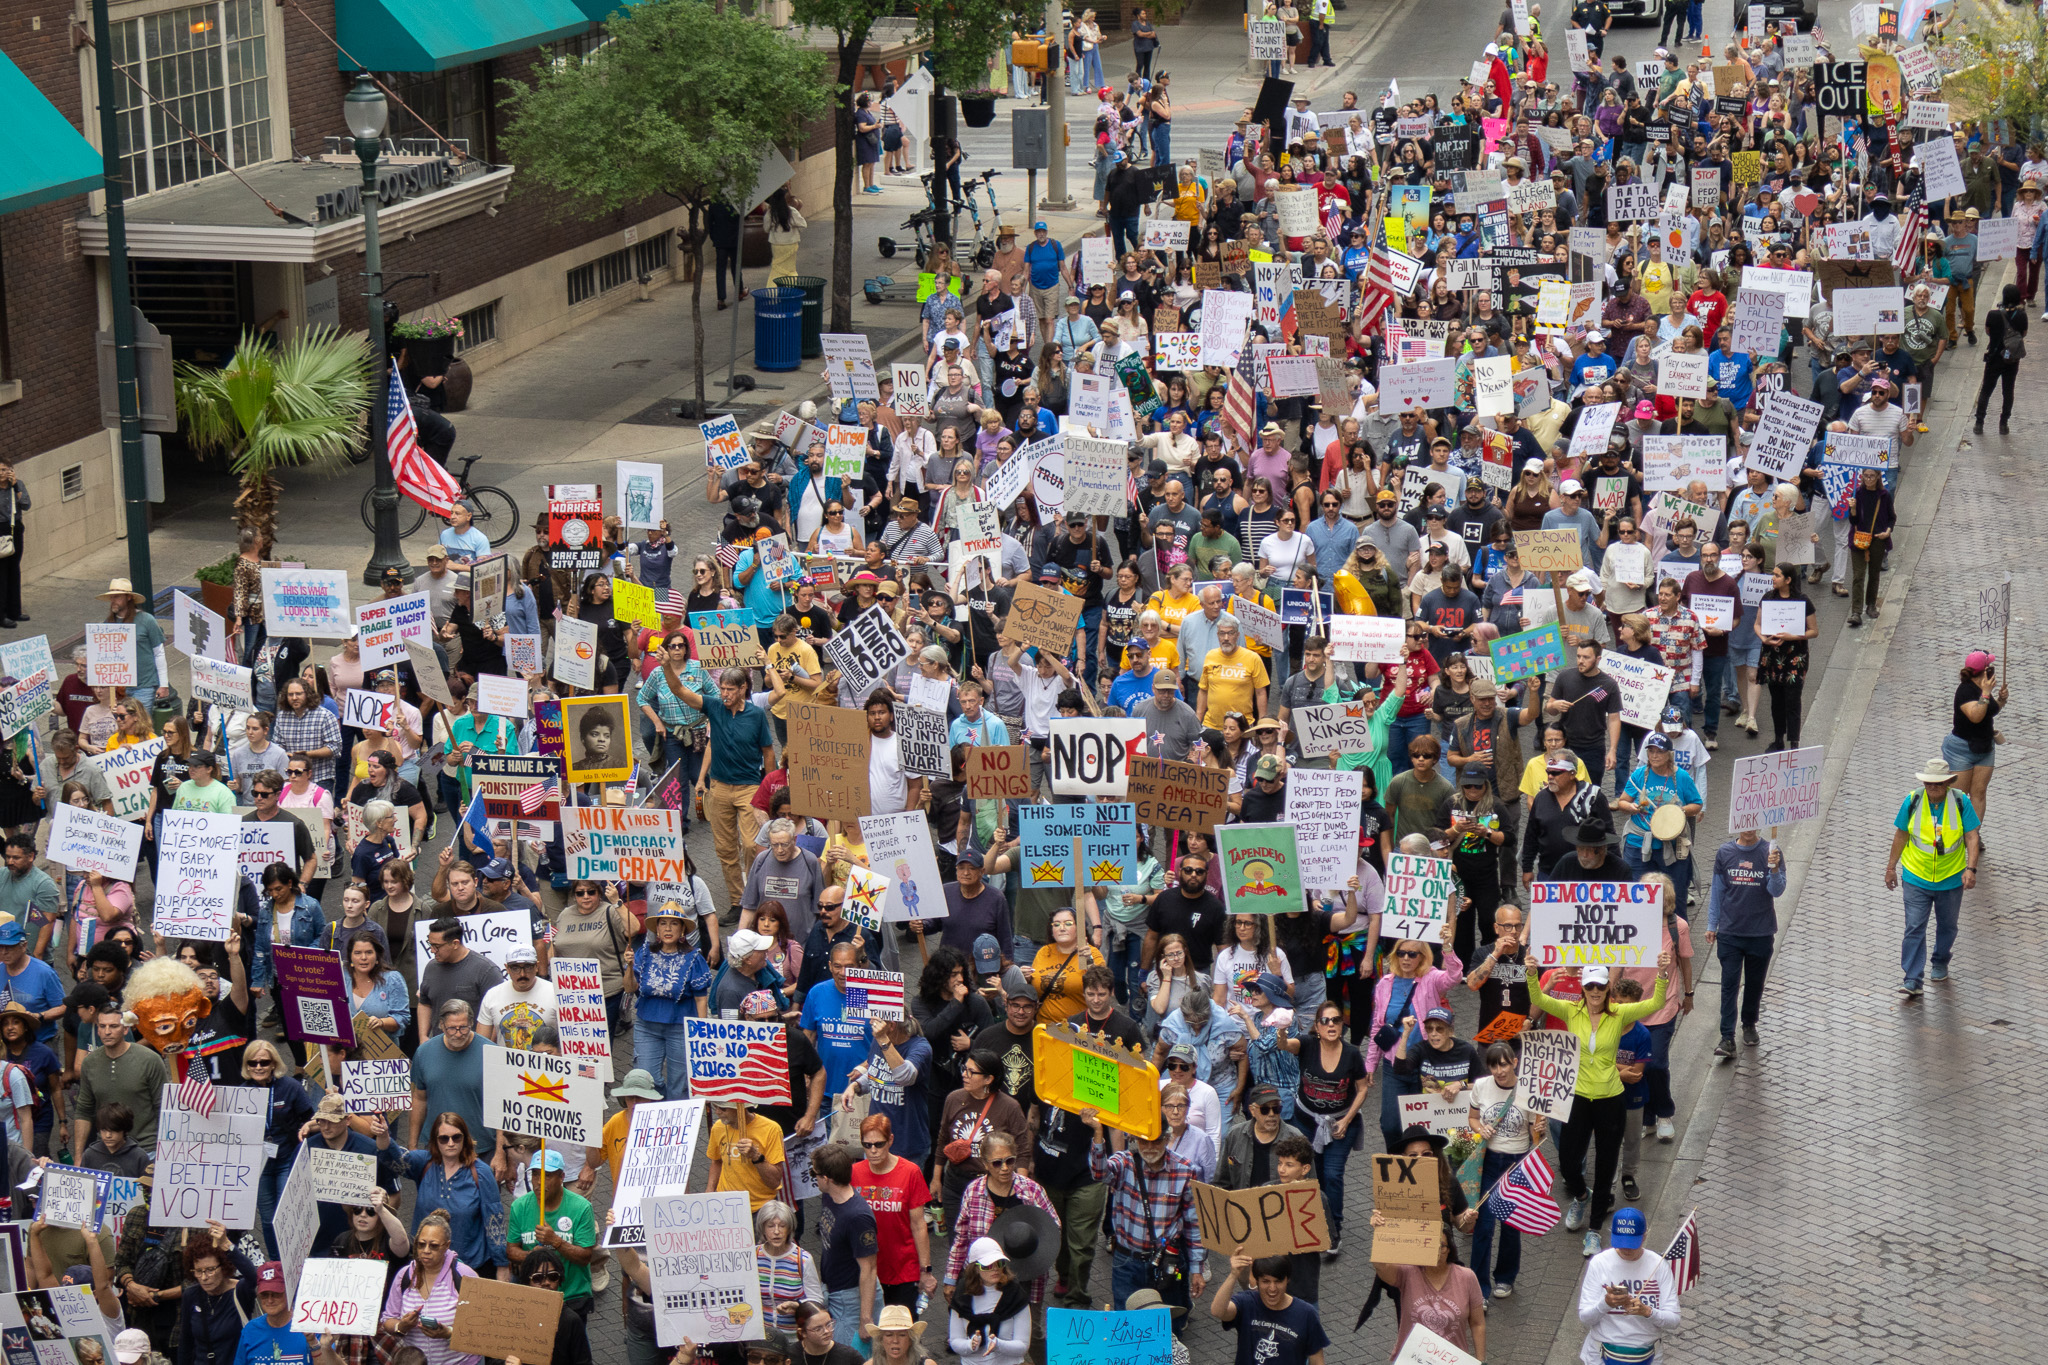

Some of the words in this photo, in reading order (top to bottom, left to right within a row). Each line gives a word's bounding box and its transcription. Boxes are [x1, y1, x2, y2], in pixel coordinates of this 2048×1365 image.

[1250, 22, 1285, 34] VETERAN
[1256, 37, 1281, 45] AGAINST
[1255, 48, 1282, 58] TRUMP
[1819, 86, 1865, 109] OUT
[1913, 105, 1945, 113] PATRIOTS
[1435, 140, 1470, 150] RAPIST
[1732, 152, 1751, 160] WHO
[1733, 160, 1758, 168] WOULD
[1696, 170, 1717, 180] STOP
[1733, 167, 1759, 175] JESUS
[1513, 186, 1554, 200] ILLEGAL
[1617, 186, 1649, 197] RATA
[1697, 187, 1717, 196] PEDO
[1520, 201, 1547, 213] LAND
[1616, 199, 1632, 208] DE
[1638, 198, 1658, 208] DOS
[1697, 196, 1718, 205] FILES
[1615, 209, 1658, 220] PATAS
[1740, 292, 1784, 307] KINGS
[1734, 320, 1779, 334] PEOPLE
[1738, 335, 1775, 352] RISE
[898, 371, 919, 387] NO
[1668, 372, 1694, 381] EXHAUST
[897, 392, 925, 403] KINGS
[828, 425, 864, 445] Chinga
[1066, 439, 1126, 455] DEMOCRACY
[1768, 436, 1778, 446] DO
[1780, 439, 1796, 451] NOT
[1756, 444, 1794, 461] MISTREAT
[825, 457, 862, 475] Migra
[1758, 454, 1784, 472] THEM
[1606, 479, 1622, 491] NO
[551, 503, 601, 512] WORKERS
[1598, 492, 1624, 507] WAR
[965, 537, 1001, 552] TYRANTS
[1514, 534, 1530, 543] NO
[1533, 532, 1576, 543] CROWN
[551, 551, 581, 560] MAKE
[583, 551, 600, 560] OUR
[1520, 554, 1579, 568] CLOWN
[552, 560, 570, 568] CITY
[572, 560, 599, 568] RUN!
[283, 597, 328, 606] DEMOCRACY
[284, 607, 309, 616] LOOKS
[312, 607, 330, 617] LIKE
[360, 608, 386, 621] SUPER
[389, 599, 425, 615] CALLOUS
[1436, 608, 1464, 628] 250
[361, 619, 392, 635] FRAGILE
[396, 611, 426, 626] RACIST
[94, 633, 127, 642] EPSTEIN
[366, 632, 393, 647] SEXIST
[700, 629, 751, 646] HANDS
[870, 607, 906, 656] NO
[99, 643, 123, 652] FILES
[711, 645, 739, 658] OFF
[854, 619, 897, 669] KINGS
[701, 656, 762, 668] DEMOCRACY
[842, 629, 878, 679] NO
[831, 639, 869, 688] BILLIONAIRES
[1606, 659, 1621, 668] TOO
[1624, 663, 1645, 675] MANY
[788, 705, 820, 720] NOT
[1305, 708, 1333, 723] NO
[1621, 708, 1639, 719] SIGN
[796, 721, 834, 737] PAID
[809, 737, 864, 757] PROTESTER
[901, 740, 944, 758] GLOBAL
[1305, 744, 1333, 753] since
[1338, 739, 1365, 750] 1776
[489, 759, 506, 771] WE
[508, 760, 534, 772] HAVE
[811, 755, 849, 769] DESPISE
[903, 753, 942, 771] WAR!
[1748, 758, 1768, 775] IS
[1778, 751, 1799, 769] HE
[1131, 760, 1227, 792] IMMIGRANTS
[1740, 776, 1777, 794] DEAD
[1783, 767, 1817, 787] YET??
[807, 783, 850, 809] FREE!
[1128, 782, 1155, 794] MAKE
[1163, 785, 1222, 808] AMERICA
[1768, 788, 1797, 805] BLOOD
[1799, 782, 1820, 800] CLOT
[579, 808, 606, 830] NO
[1022, 807, 1054, 820] THIS
[1071, 807, 1084, 818] IS
[1097, 805, 1131, 821] NOT
[1137, 804, 1208, 825] GREAT
[1733, 812, 1758, 829] WORK
[1763, 808, 1785, 825] YOUR
[1045, 824, 1110, 836] SOMEONE
[614, 847, 634, 855] NOT
[638, 848, 665, 857] YOUR
[1025, 845, 1069, 857] ELSES
[1088, 845, 1130, 856] FIGHT
[1391, 856, 1450, 879] CLEAN
[1727, 869, 1764, 878] VETERANS
[1387, 875, 1416, 894] UP
[1422, 880, 1449, 900] ON
[1532, 883, 1661, 904] DEMOCRACY
[1385, 900, 1442, 920] AISLE
[1575, 905, 1618, 925] NOT
[155, 921, 233, 938] PRESIDENT
[1395, 920, 1431, 939] 47
[1559, 925, 1638, 944] TRUMP
[305, 954, 339, 963] reminder
[1543, 945, 1647, 964] DYNASTY
[304, 967, 324, 975] vote?
[848, 970, 864, 979] PRO
[866, 971, 902, 983] AMERICA
[847, 1009, 864, 1017] ANTI
[870, 1010, 900, 1021] TRUMP!
[822, 1024, 833, 1032] NO
[836, 1025, 864, 1035] KINGS
[1523, 1031, 1576, 1051] HUMAN
[1524, 1044, 1572, 1064] RIGHTS
[506, 1052, 525, 1066] NO
[528, 1057, 571, 1075] KINGS
[1523, 1060, 1575, 1084] BELONG
[503, 1099, 522, 1115] NO
[527, 1105, 582, 1125] CROWNS
[1406, 1102, 1429, 1111] NOT
[1434, 1108, 1446, 1116] MY
[1448, 1107, 1467, 1115] KING
[1528, 1096, 1552, 1114] ONE
[502, 1117, 521, 1133] NO
[526, 1121, 586, 1142] THRONES
[170, 1164, 250, 1186] BETTER
[1376, 1158, 1418, 1184] TX
[161, 1188, 242, 1220] VOTE
[654, 1198, 742, 1228] ABORT
[654, 1227, 753, 1254] UNWANTED
[653, 1252, 752, 1276] PRESIDENCY
[299, 1301, 357, 1325] SCARED
[1067, 1317, 1094, 1342] NO
